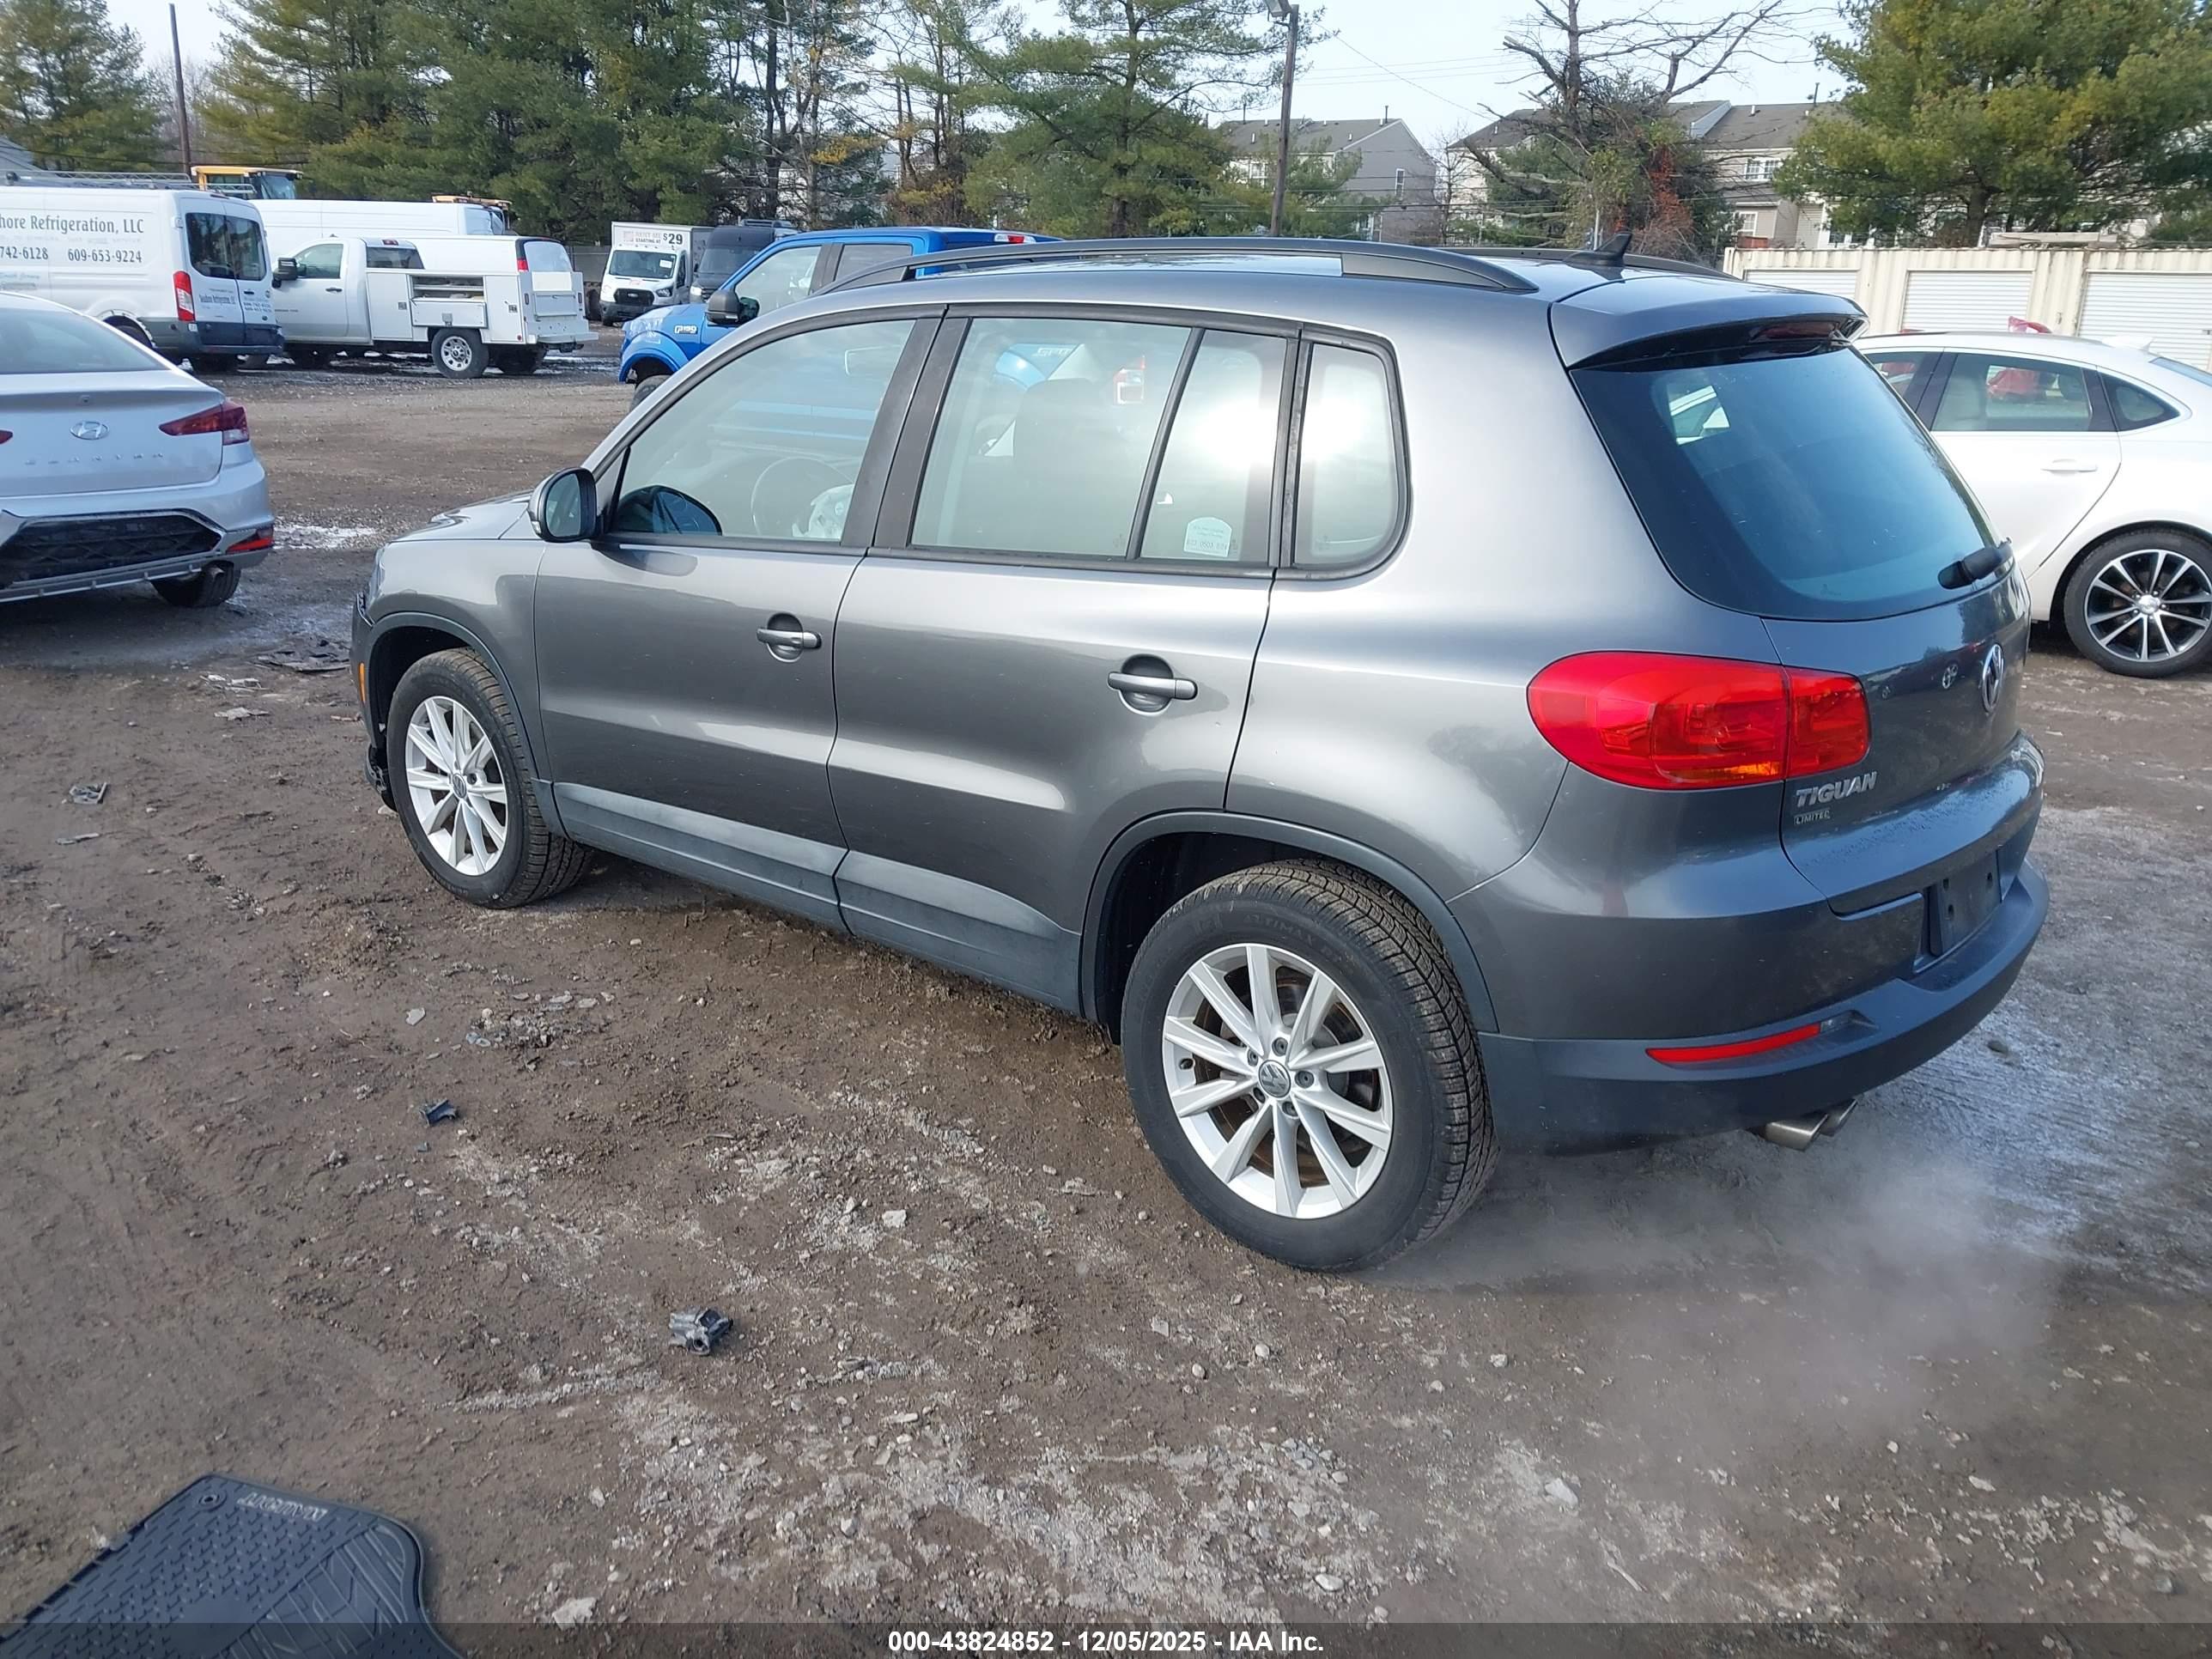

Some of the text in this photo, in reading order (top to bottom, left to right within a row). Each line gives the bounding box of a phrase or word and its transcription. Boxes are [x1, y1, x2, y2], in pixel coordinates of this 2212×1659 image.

[31, 215, 118, 234] Refrigeration,
[123, 219, 144, 233] LLC
[68, 248, 143, 264] 609-653-9224
[1796, 771, 1877, 808] TIGUAN
